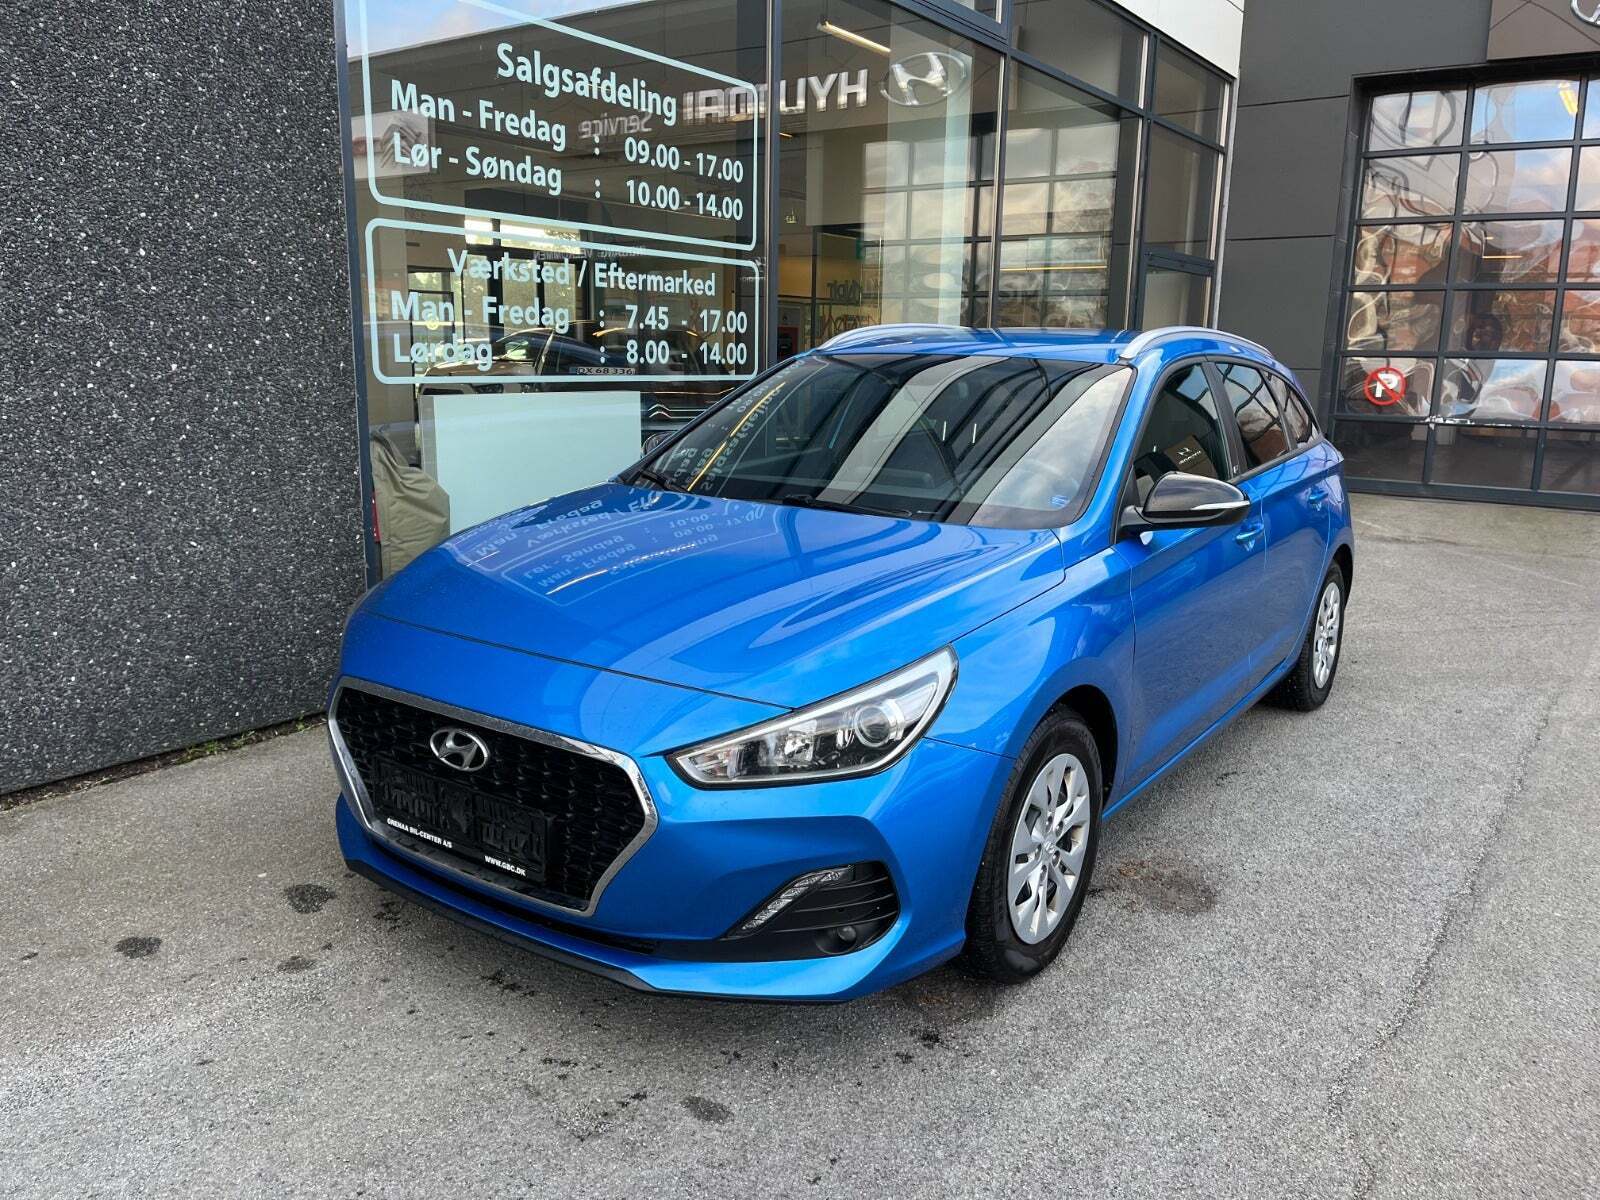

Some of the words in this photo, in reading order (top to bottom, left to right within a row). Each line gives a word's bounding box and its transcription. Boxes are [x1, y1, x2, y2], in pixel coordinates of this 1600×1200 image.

[497, 42, 677, 126] Salgsafdeling
[391, 79, 455, 122] Man
[479, 99, 566, 152] Fredag
[624, 136, 680, 171] 09.00
[696, 152, 744, 183] 17.00
[393, 132, 442, 168] Lør
[465, 146, 562, 195] Søndag
[626, 179, 680, 211] 10.00
[696, 192, 743, 221] 14.00
[447, 248, 570, 285] Værksted
[594, 262, 716, 296] Eftermarked
[391, 290, 454, 321] Man
[482, 296, 569, 334] Fredag
[625, 304, 669, 331] 7.45
[700, 309, 748, 334] 17.00
[393, 333, 492, 371] Lørdag
[626, 339, 670, 365] 8.00
[700, 342, 747, 365] 14.00
